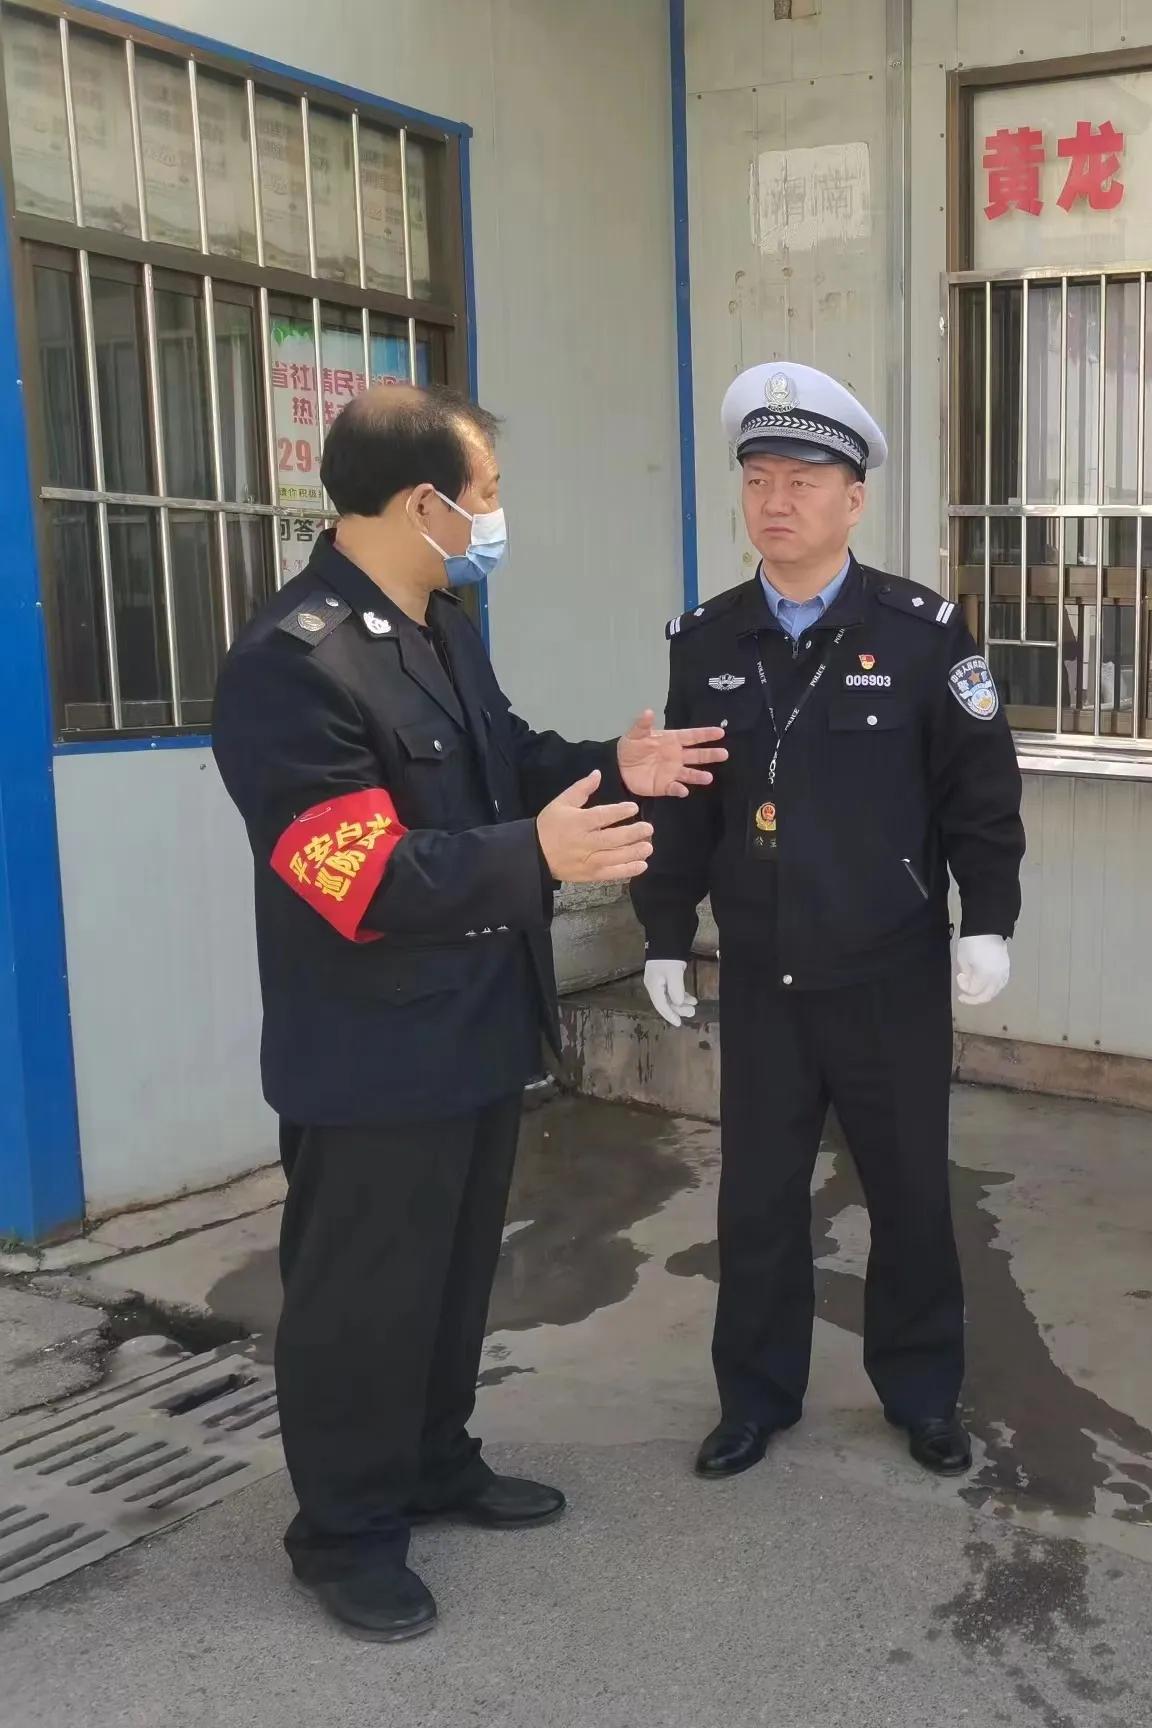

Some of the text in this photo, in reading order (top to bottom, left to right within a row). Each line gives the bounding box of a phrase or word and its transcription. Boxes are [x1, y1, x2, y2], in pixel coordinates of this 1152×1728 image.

[981, 120, 1125, 220] 黄龙
[756, 659, 768, 685] POLICE
[808, 663, 827, 688] POLICE
[845, 674, 892, 688] 006903
